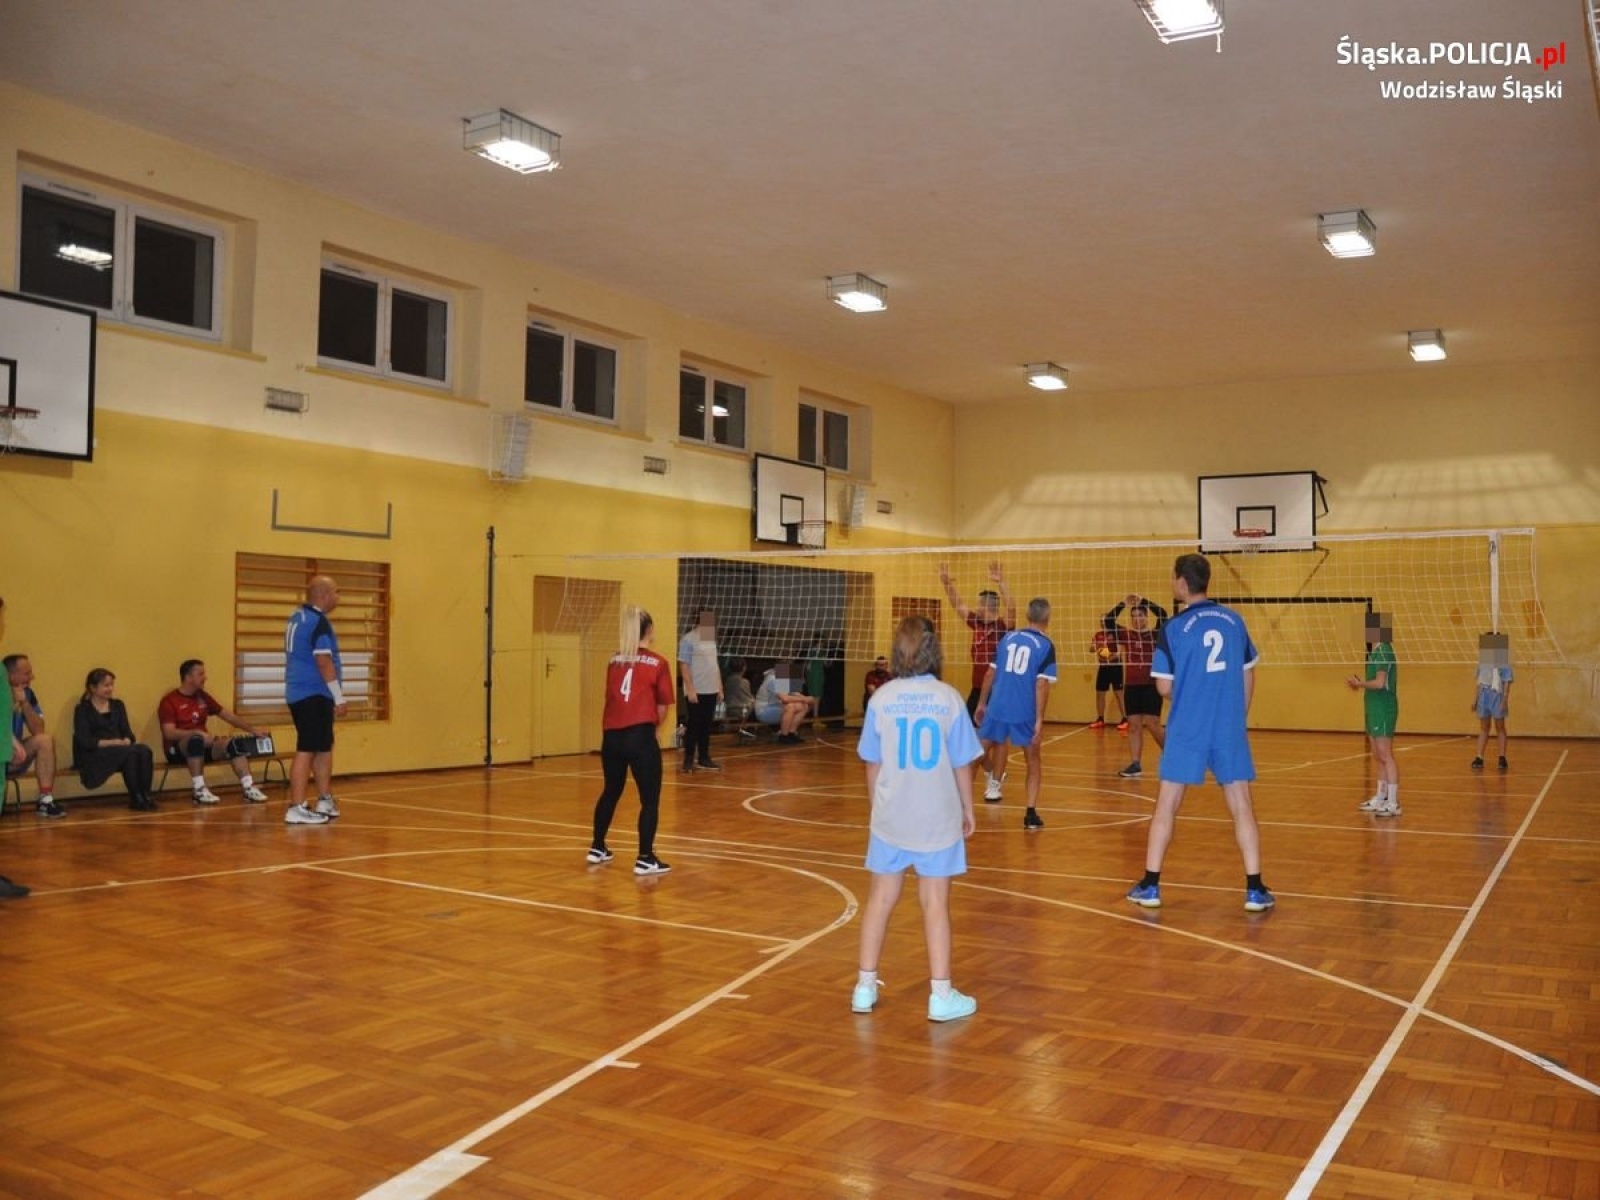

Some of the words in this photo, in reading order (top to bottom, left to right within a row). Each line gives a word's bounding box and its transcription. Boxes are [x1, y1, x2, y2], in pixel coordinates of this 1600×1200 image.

[1005, 643, 1032, 676] 10
[1203, 629, 1227, 673] 2
[620, 667, 633, 702] 4
[895, 716, 942, 771] 10
